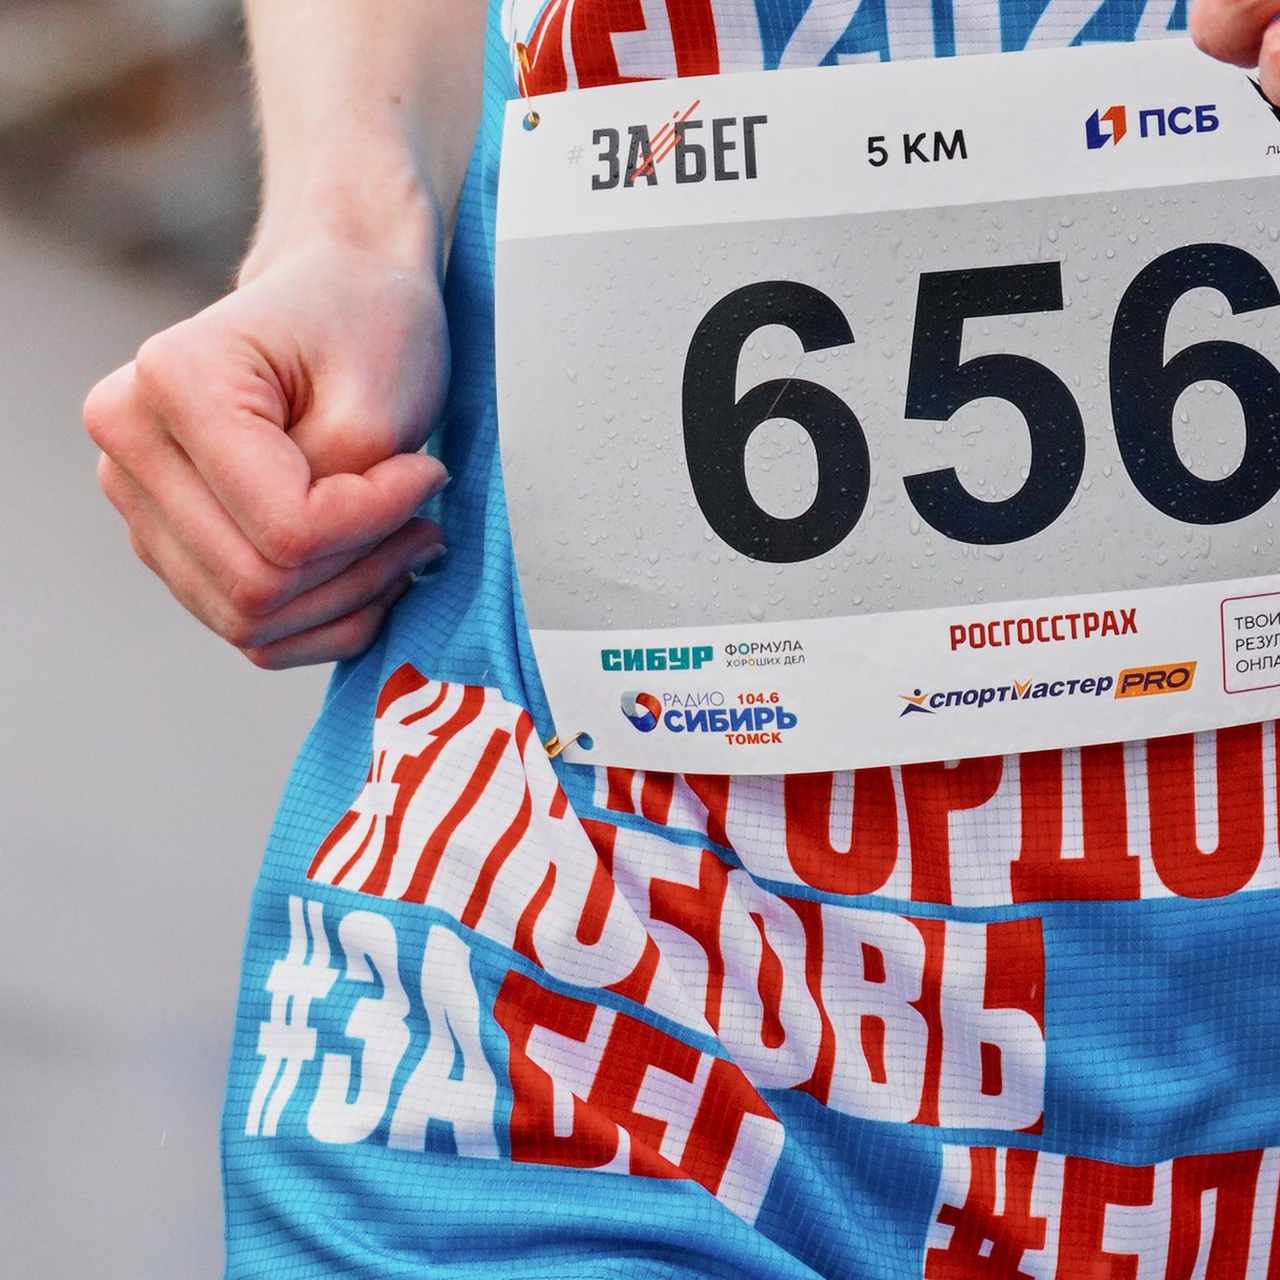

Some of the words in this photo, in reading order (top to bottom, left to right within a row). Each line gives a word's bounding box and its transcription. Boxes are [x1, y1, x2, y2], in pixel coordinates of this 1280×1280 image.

[1139, 104, 1220, 138] ПСБ
[867, 135, 889, 167] 5
[903, 129, 968, 164] КМ
[950, 608, 1138, 651] РОСГОССТРАХ
[601, 645, 714, 671] СИБУР
[725, 640, 804, 656] ФОРМУЛА
[726, 656, 782, 669] ХОРОШИХ
[783, 654, 806, 666] ДЕЛ
[1121, 667, 1191, 694] PRO
[663, 691, 725, 707] РАДИО
[737, 692, 780, 705] 104.6
[664, 705, 798, 733] СИБИРЬ
[725, 732, 783, 745] ТОМСК
